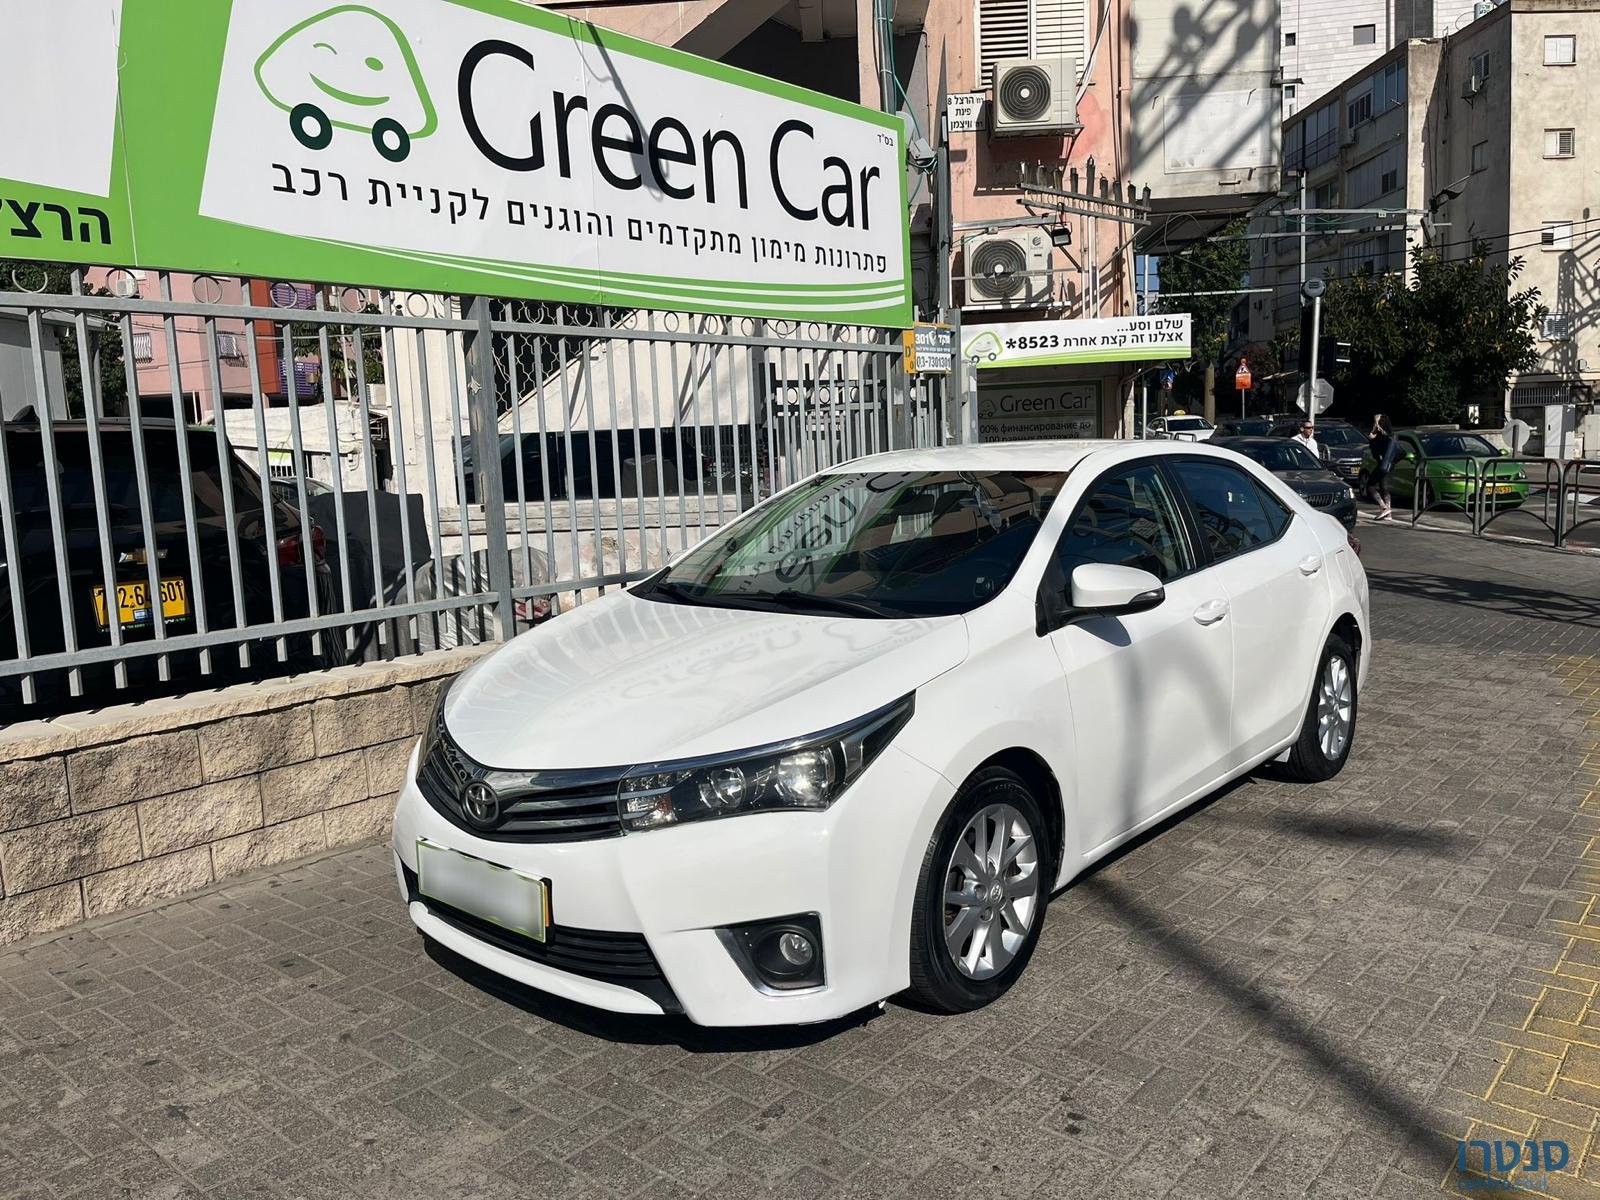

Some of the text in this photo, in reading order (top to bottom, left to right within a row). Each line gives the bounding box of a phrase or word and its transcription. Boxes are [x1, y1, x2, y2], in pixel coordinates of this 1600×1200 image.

[947, 97, 953, 106] 8
[954, 95, 974, 105] הרצל
[955, 107, 972, 117] פינת
[457, 39, 881, 231] Green Car
[0, 197, 112, 245] הרצ
[271, 163, 887, 274] פתרונות מימון מתקדמים והוגנים לקניית רכב
[1155, 319, 1183, 330] שלם
[1063, 337, 1097, 348] אחרת
[1101, 335, 1127, 347] קצת
[1131, 334, 1145, 344] זה
[1148, 331, 1183, 343] אצלנו
[999, 391, 1091, 413] Green Car
[979, 424, 998, 434] 00%
